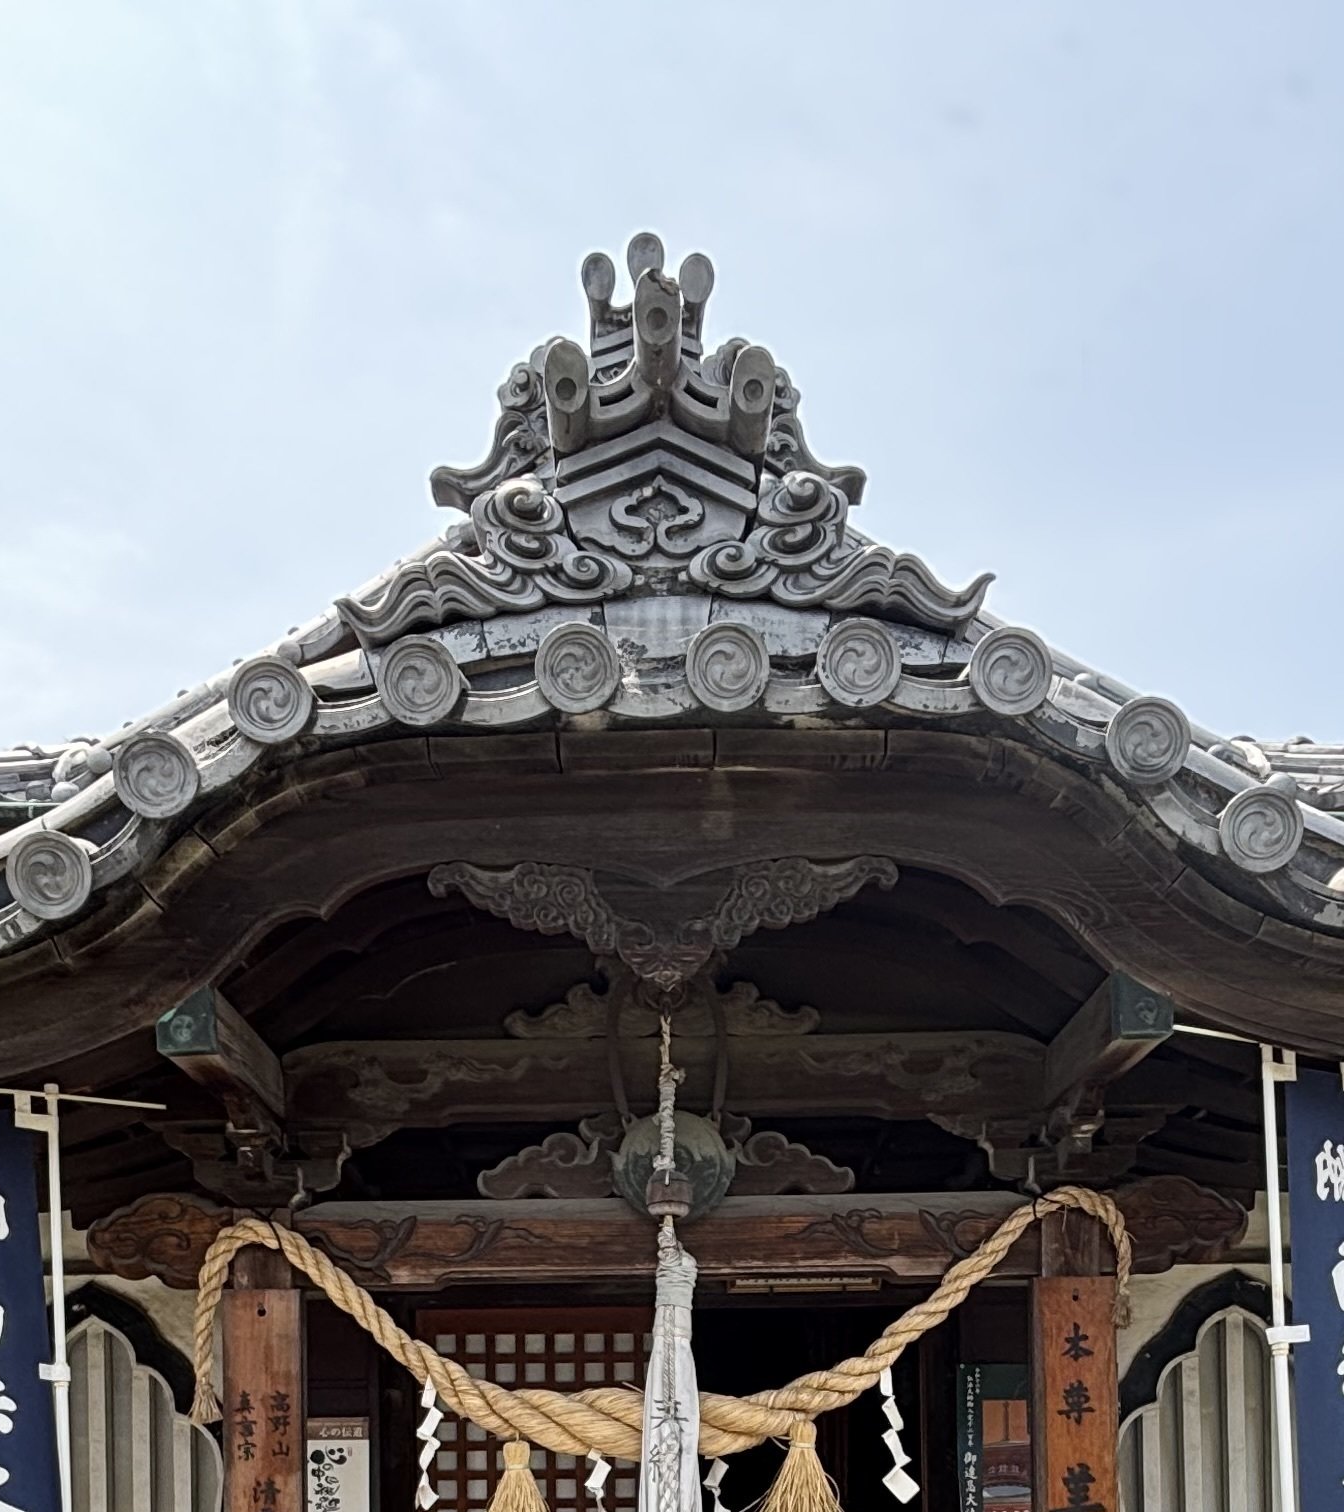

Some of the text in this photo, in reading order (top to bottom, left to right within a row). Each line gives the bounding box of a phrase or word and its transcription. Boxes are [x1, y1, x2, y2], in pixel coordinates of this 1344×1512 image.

[1057, 1322, 1097, 1426] 本尊
[235, 1390, 257, 1461] 真言宗
[269, 1390, 291, 1458] 高野山
